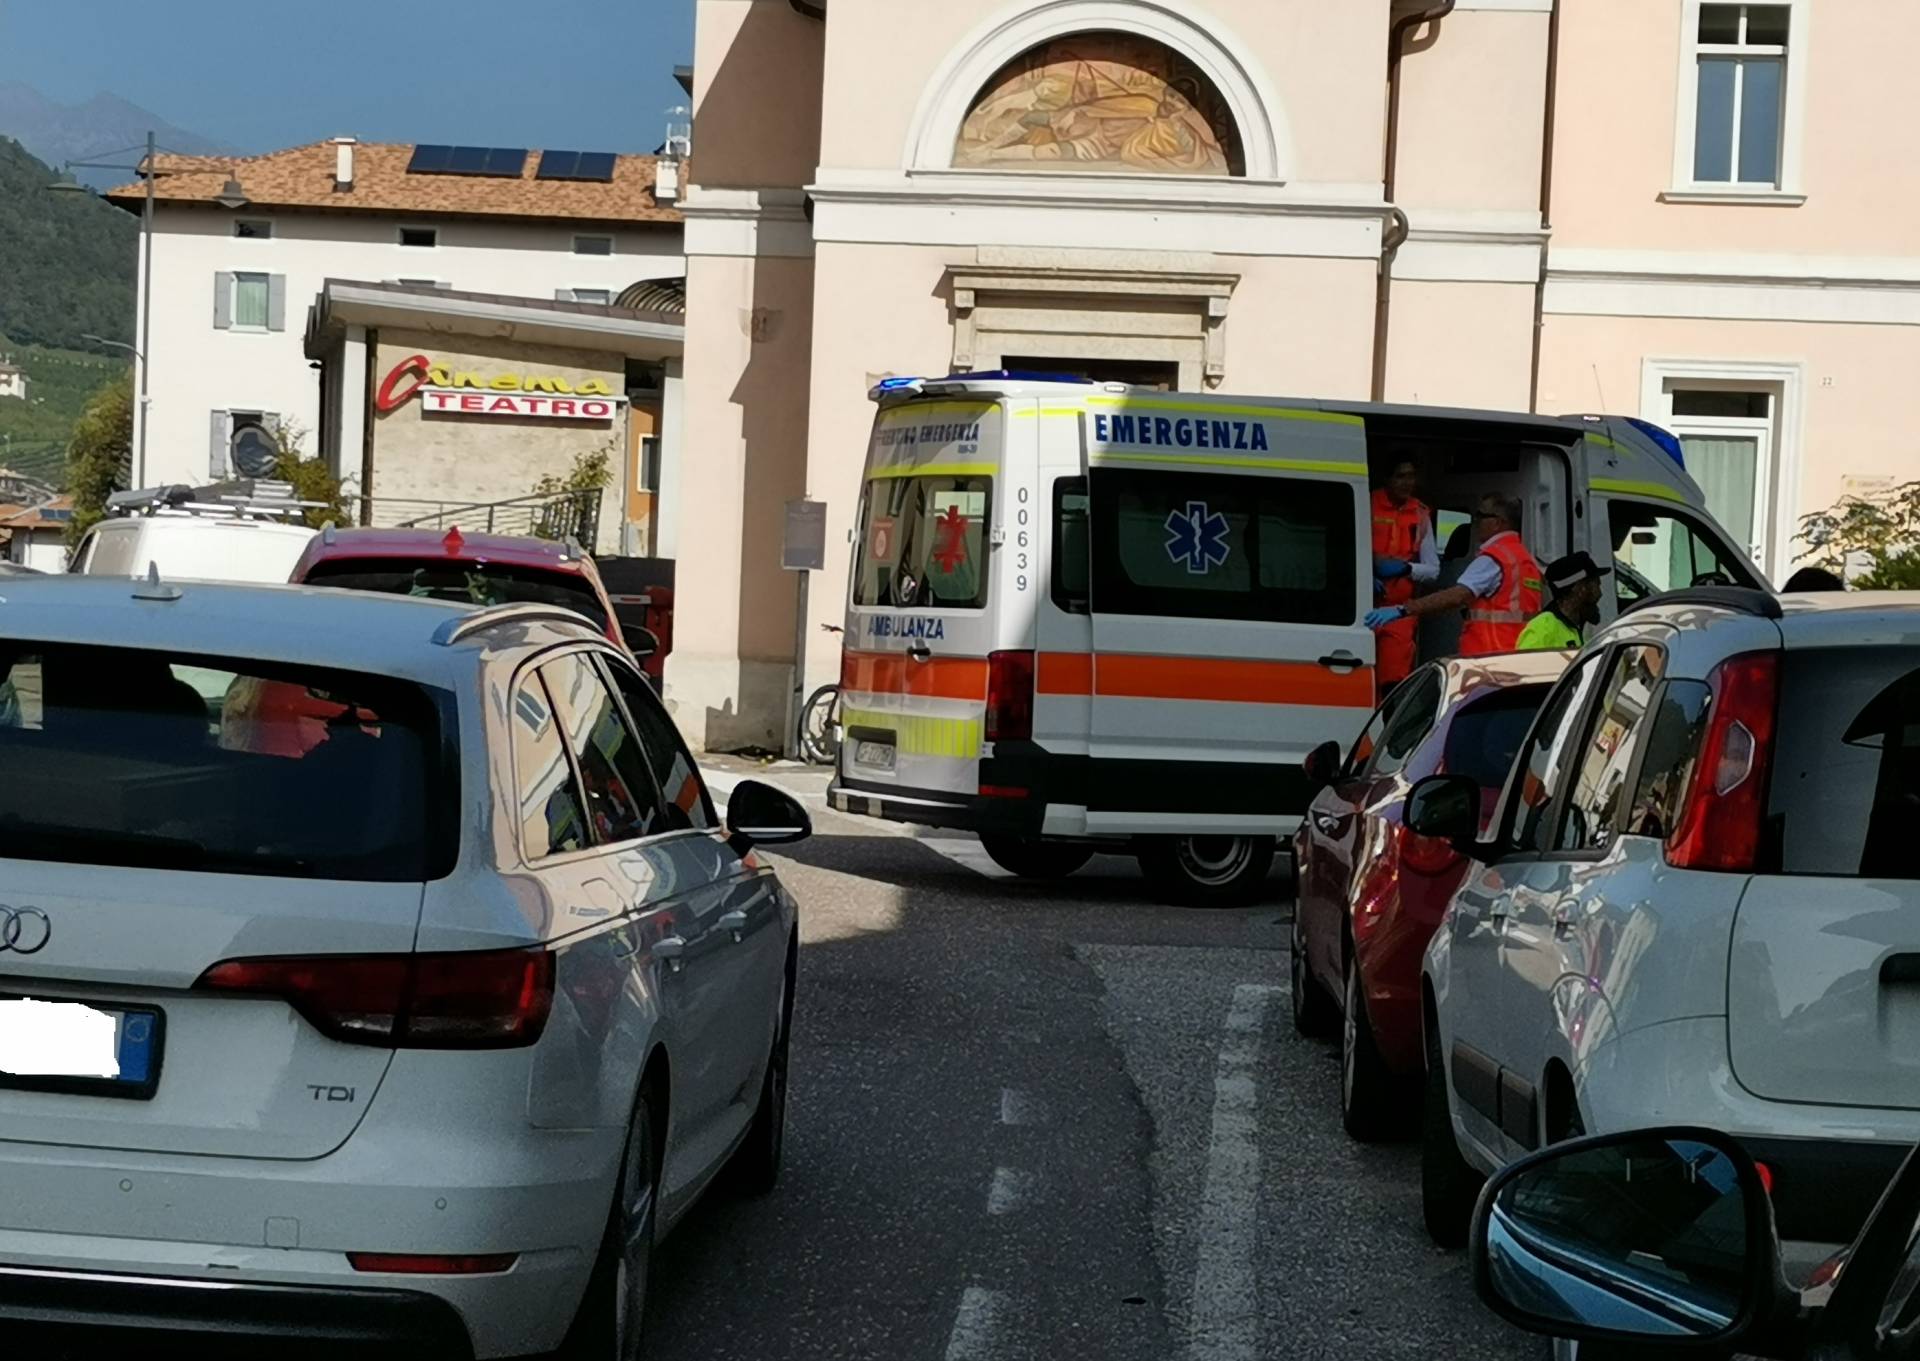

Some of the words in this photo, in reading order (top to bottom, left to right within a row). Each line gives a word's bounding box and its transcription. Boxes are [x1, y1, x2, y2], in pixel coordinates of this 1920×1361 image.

[376, 354, 613, 411] Cinema
[428, 393, 610, 417] TEATRO
[1094, 413, 1269, 451] EMERGENZA
[1016, 486, 1029, 592] 00639
[867, 614, 945, 640] AMBULANZA
[306, 1084, 356, 1103] TDI
